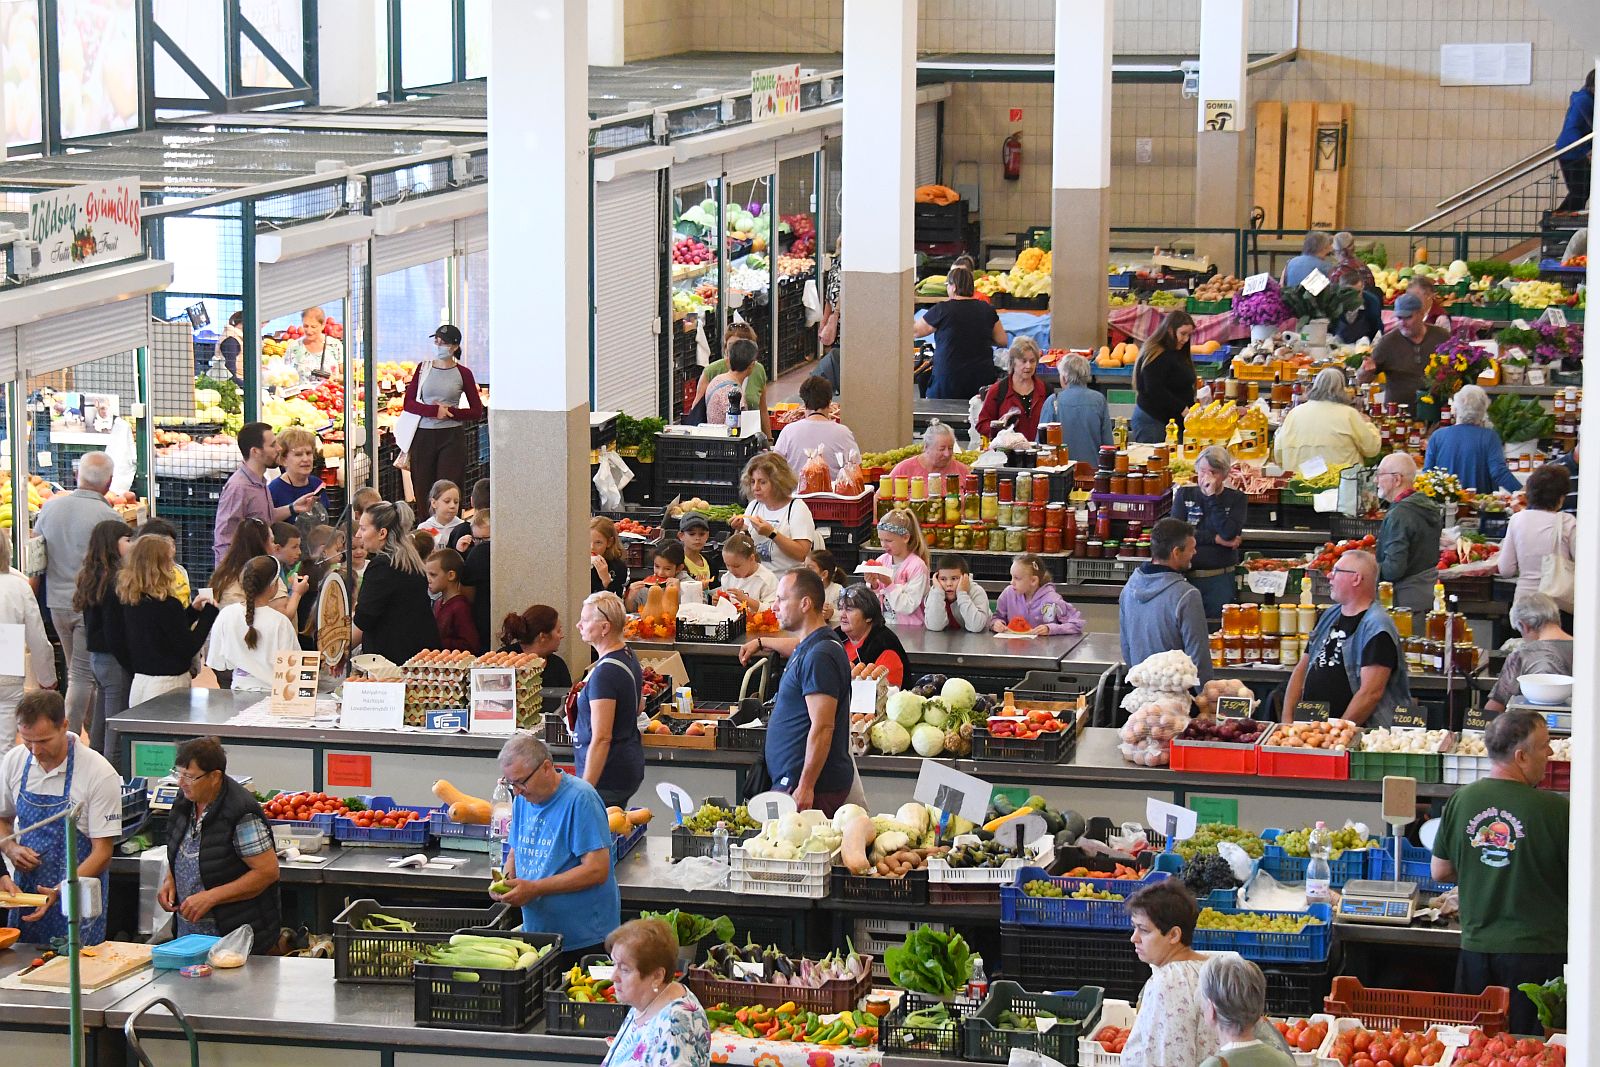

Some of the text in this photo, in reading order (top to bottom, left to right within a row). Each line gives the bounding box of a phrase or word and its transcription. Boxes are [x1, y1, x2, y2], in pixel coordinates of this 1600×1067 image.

[32, 186, 140, 245] Zöldség Gyümölcs
[276, 656, 283, 664] S
[274, 671, 284, 680] M
[273, 688, 279, 696] L
